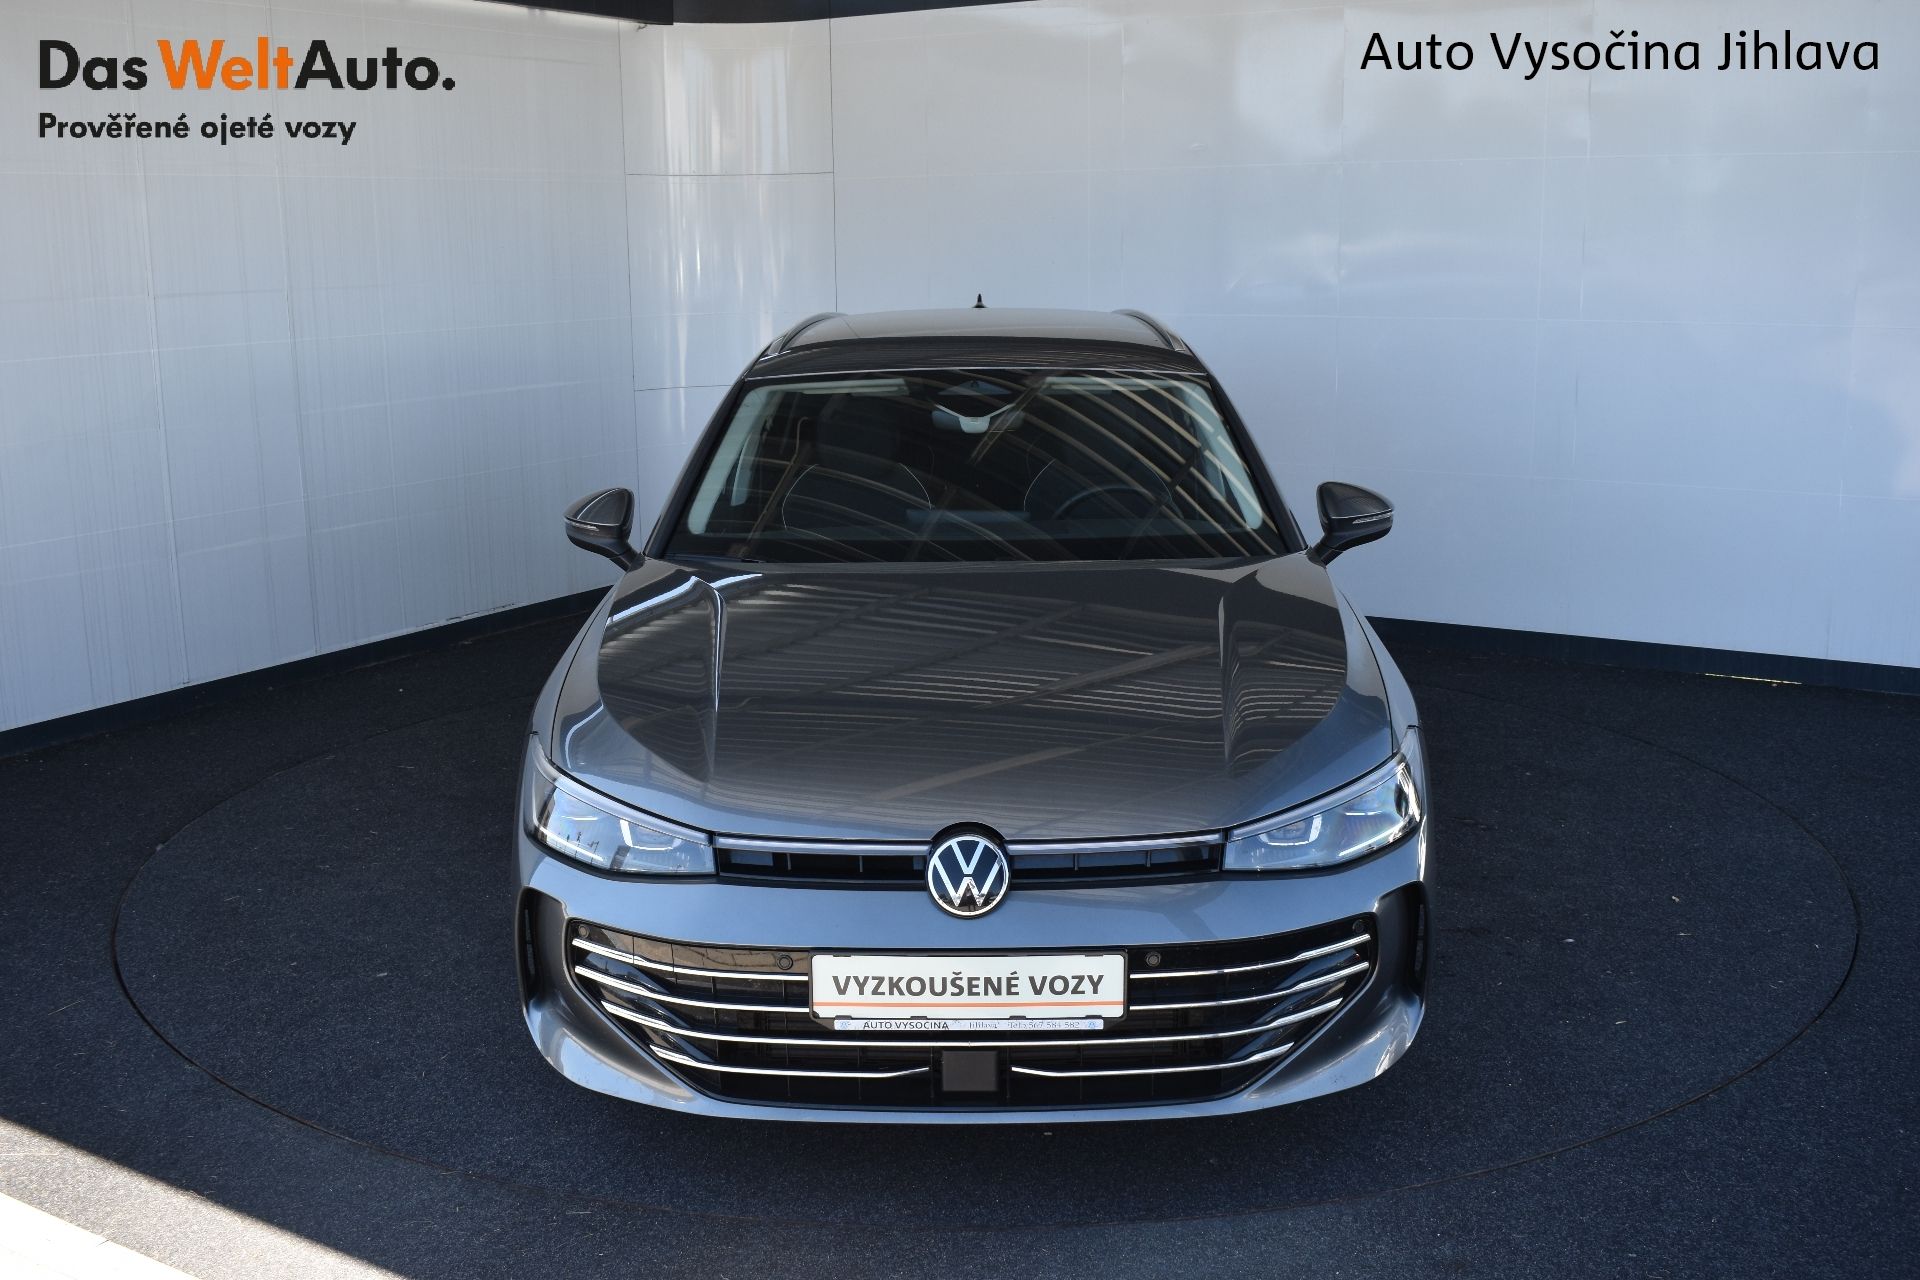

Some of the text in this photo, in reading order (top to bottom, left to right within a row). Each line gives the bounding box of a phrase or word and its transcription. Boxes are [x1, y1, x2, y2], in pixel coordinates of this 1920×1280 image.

[832, 970, 1105, 997] VYZKOUŠENÉ VOZY
[863, 1021, 892, 1030] AUTO
[1064, 1021, 1080, 1029] 582
